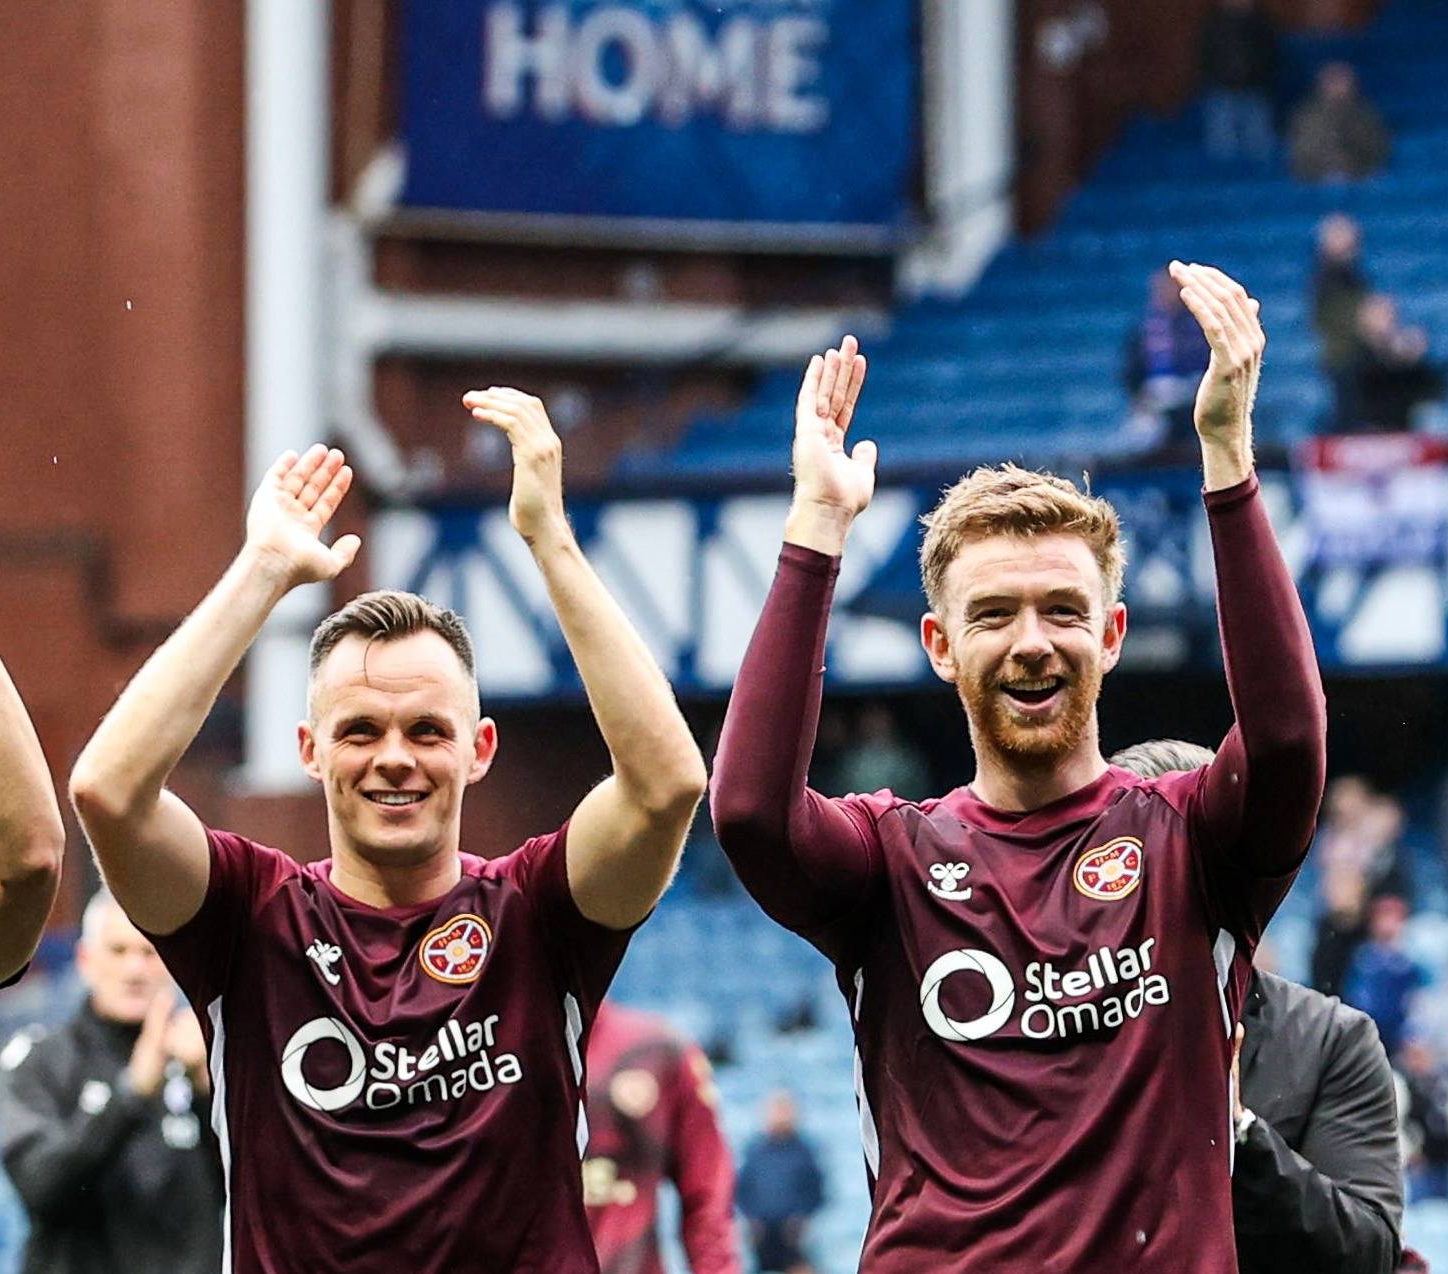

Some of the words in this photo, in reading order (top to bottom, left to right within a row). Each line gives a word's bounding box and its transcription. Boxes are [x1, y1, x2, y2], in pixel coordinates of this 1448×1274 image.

[484, 2, 829, 132] HOME
[1024, 937, 1155, 1002] Stellar
[1020, 974, 1170, 1039] Omada
[370, 1014, 499, 1080] Stellar
[366, 1050, 523, 1110] Omada
